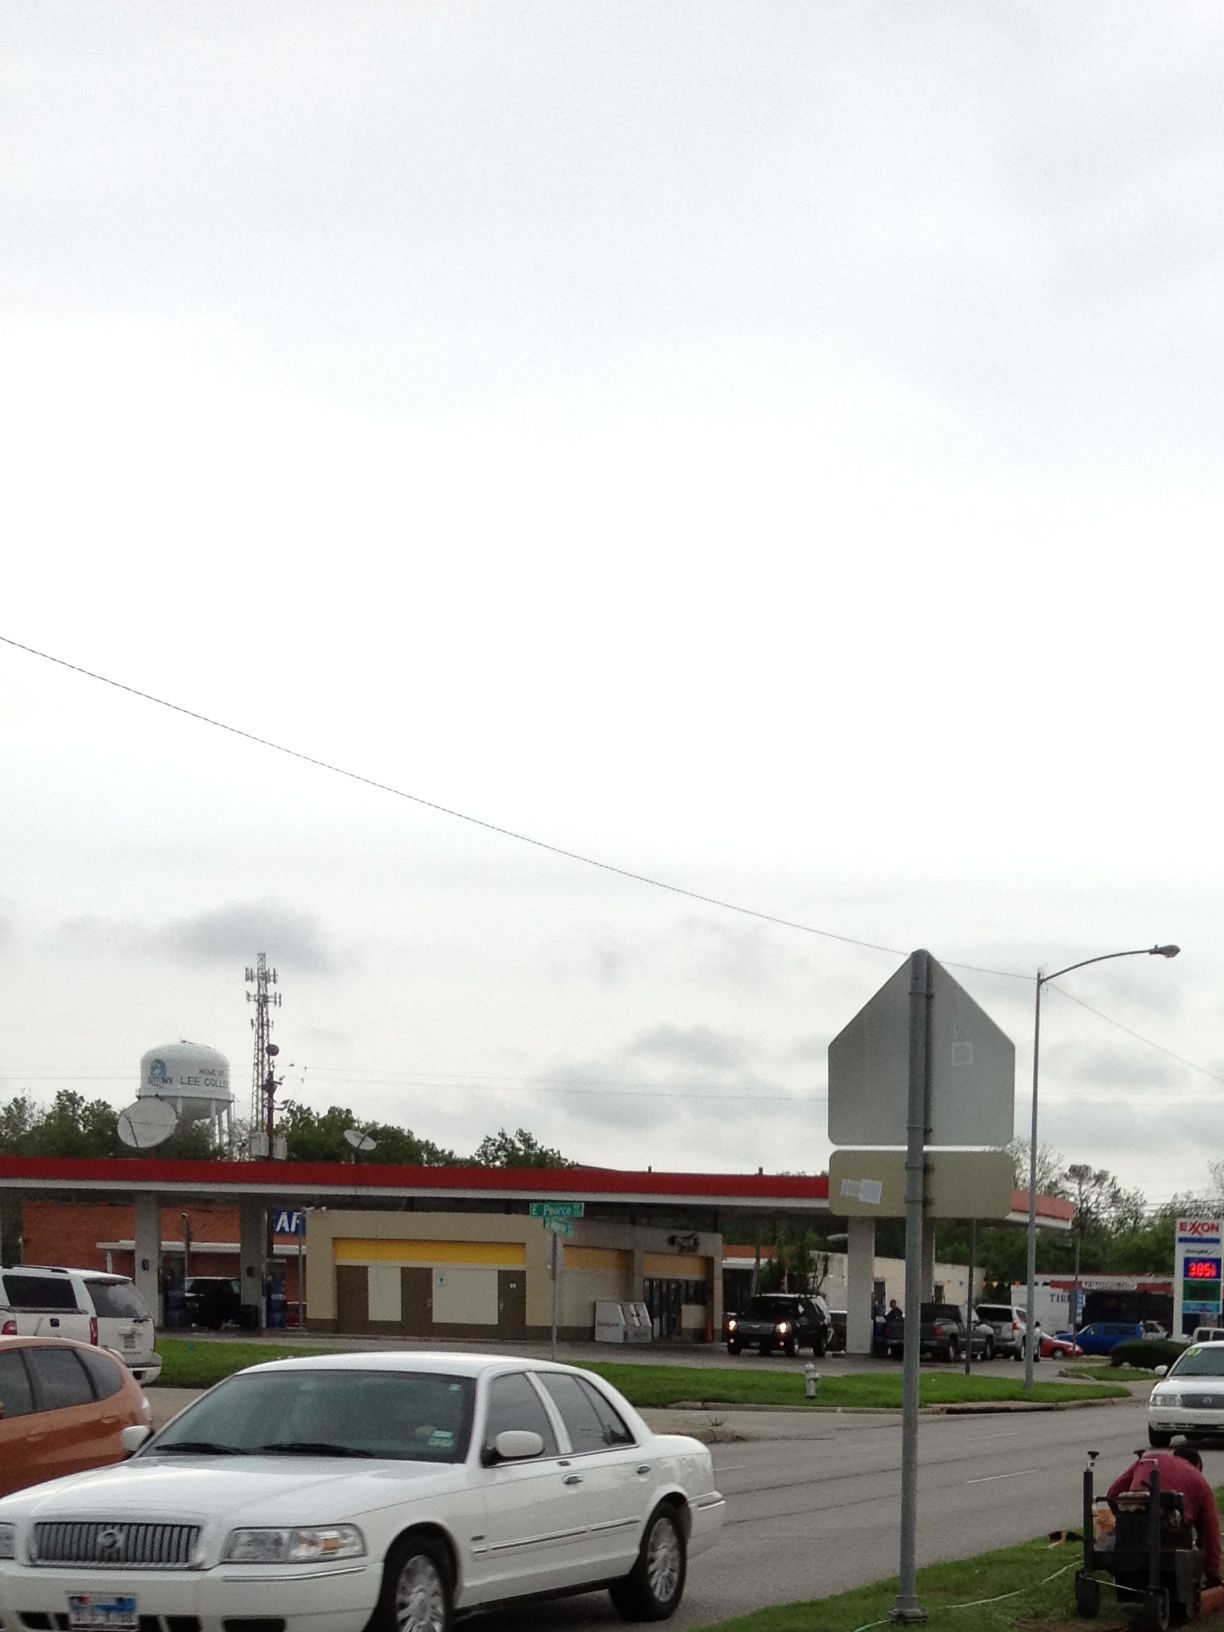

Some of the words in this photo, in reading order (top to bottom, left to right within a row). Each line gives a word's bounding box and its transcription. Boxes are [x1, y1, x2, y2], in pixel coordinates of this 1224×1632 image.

[180, 1076, 200, 1086] LEE
[204, 1078, 229, 1089] COLLE
[532, 1204, 538, 1215] E
[1179, 1221, 1219, 1236] EXXON
